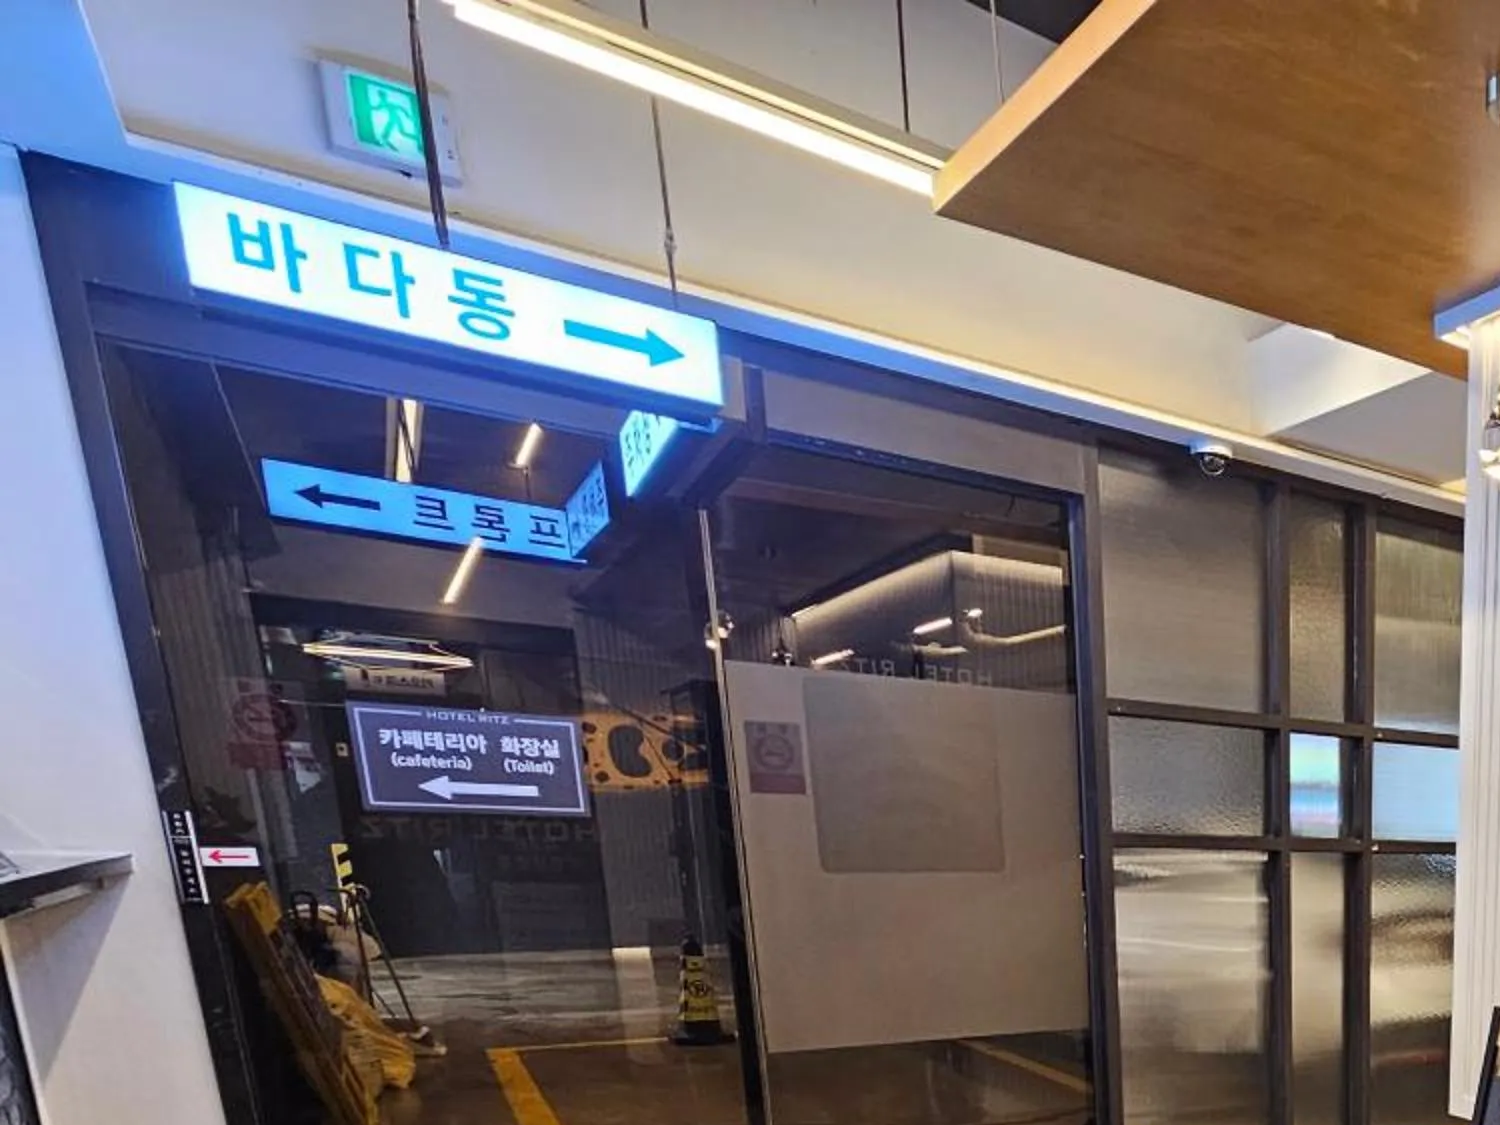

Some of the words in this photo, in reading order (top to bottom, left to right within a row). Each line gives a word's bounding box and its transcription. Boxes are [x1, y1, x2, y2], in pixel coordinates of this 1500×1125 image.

[426, 710, 475, 722] HOTEL
[379, 728, 487, 755] 카페테리아
[500, 734, 561, 760] 화장실
[391, 751, 473, 771] (cafeteria)
[504, 757, 555, 777] (Toilet)
